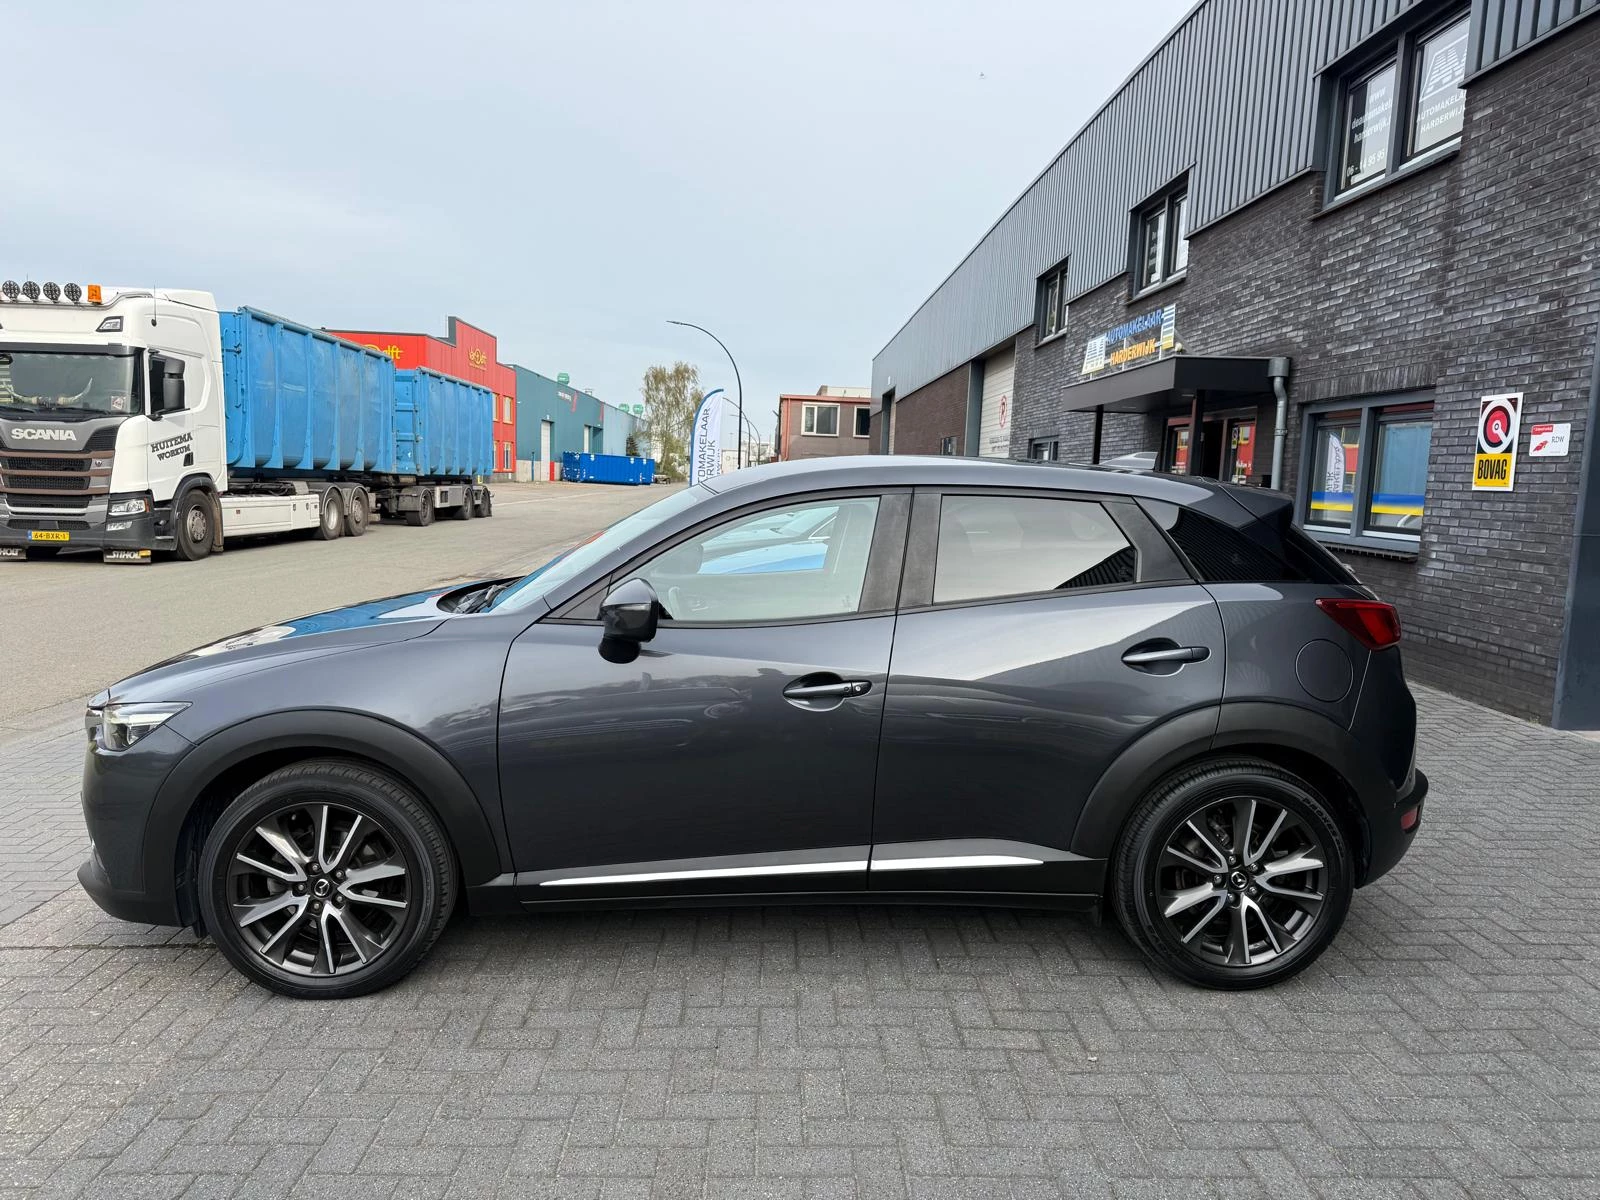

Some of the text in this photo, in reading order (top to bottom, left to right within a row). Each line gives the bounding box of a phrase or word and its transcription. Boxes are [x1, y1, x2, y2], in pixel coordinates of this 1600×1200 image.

[1105, 308, 1162, 344] AUTOMAKELAAR
[1110, 338, 1156, 366] HARDERWIJK
[11, 428, 76, 441] SCANIA
[150, 432, 193, 453] HUITEMA
[156, 444, 190, 462] WORKUM
[1477, 459, 1508, 480] BOVAG
